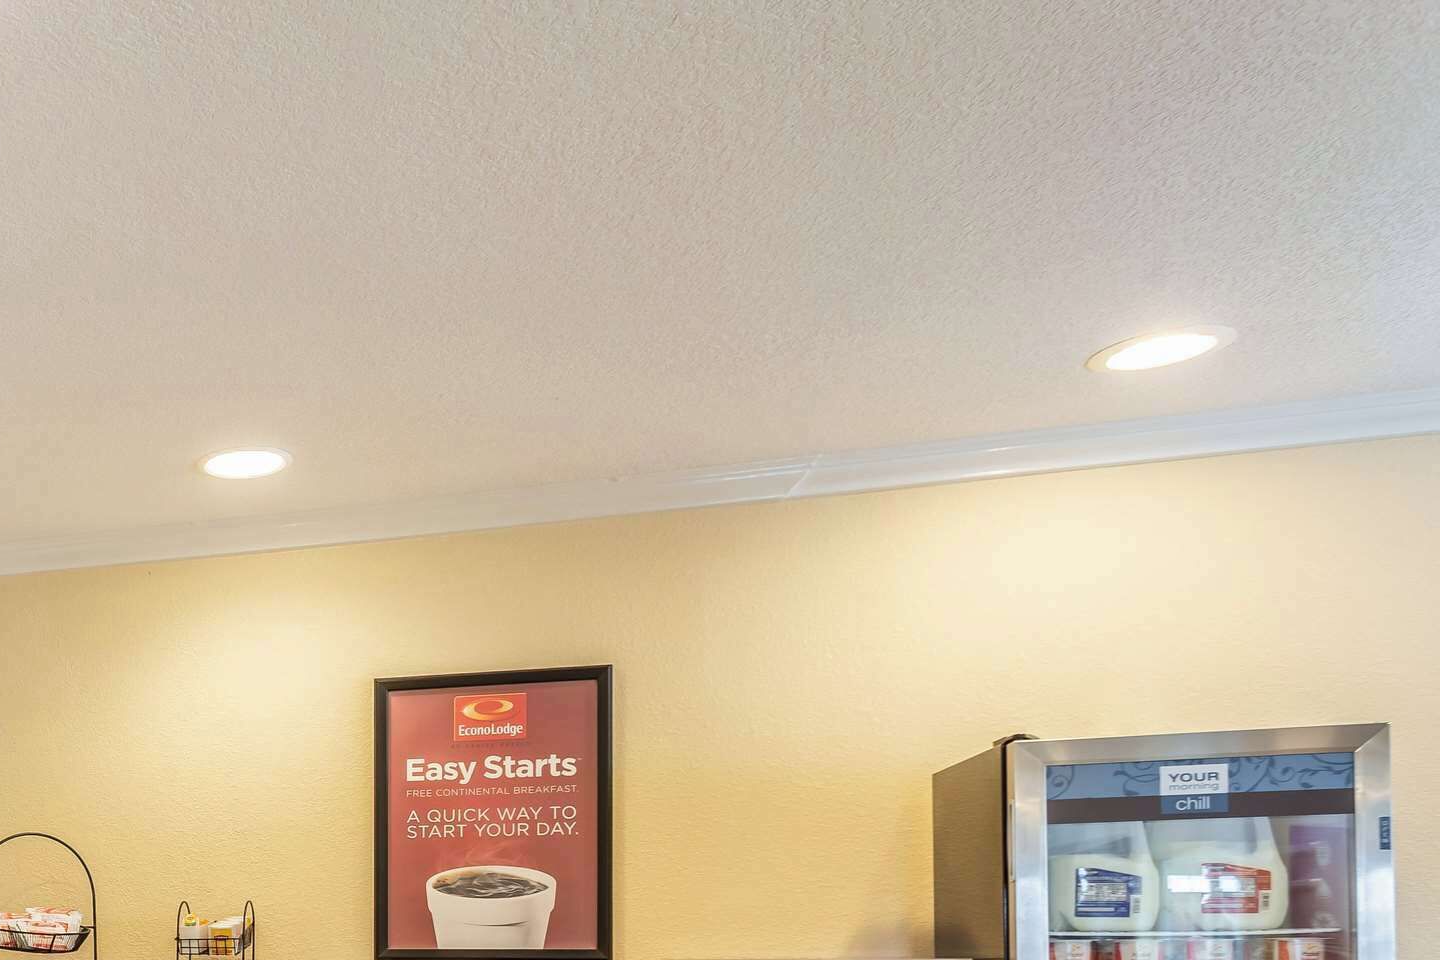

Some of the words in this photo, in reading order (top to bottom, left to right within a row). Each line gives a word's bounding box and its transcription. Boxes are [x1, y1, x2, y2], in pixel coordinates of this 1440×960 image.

[458, 723, 524, 737] EconoLodge
[406, 758, 477, 785] Easy
[484, 754, 577, 780] Starts
[1168, 771, 1220, 783] YOUR
[406, 789, 432, 798] FREE
[435, 787, 510, 797] CONTINENTAL
[1175, 796, 1210, 811] chill
[407, 810, 420, 824] A
[427, 808, 490, 824] QUICK
[497, 807, 542, 821] WAY
[550, 805, 577, 820] TO
[407, 824, 467, 839] START
[474, 823, 530, 838] YOUR
[536, 822, 579, 837] DAY.
